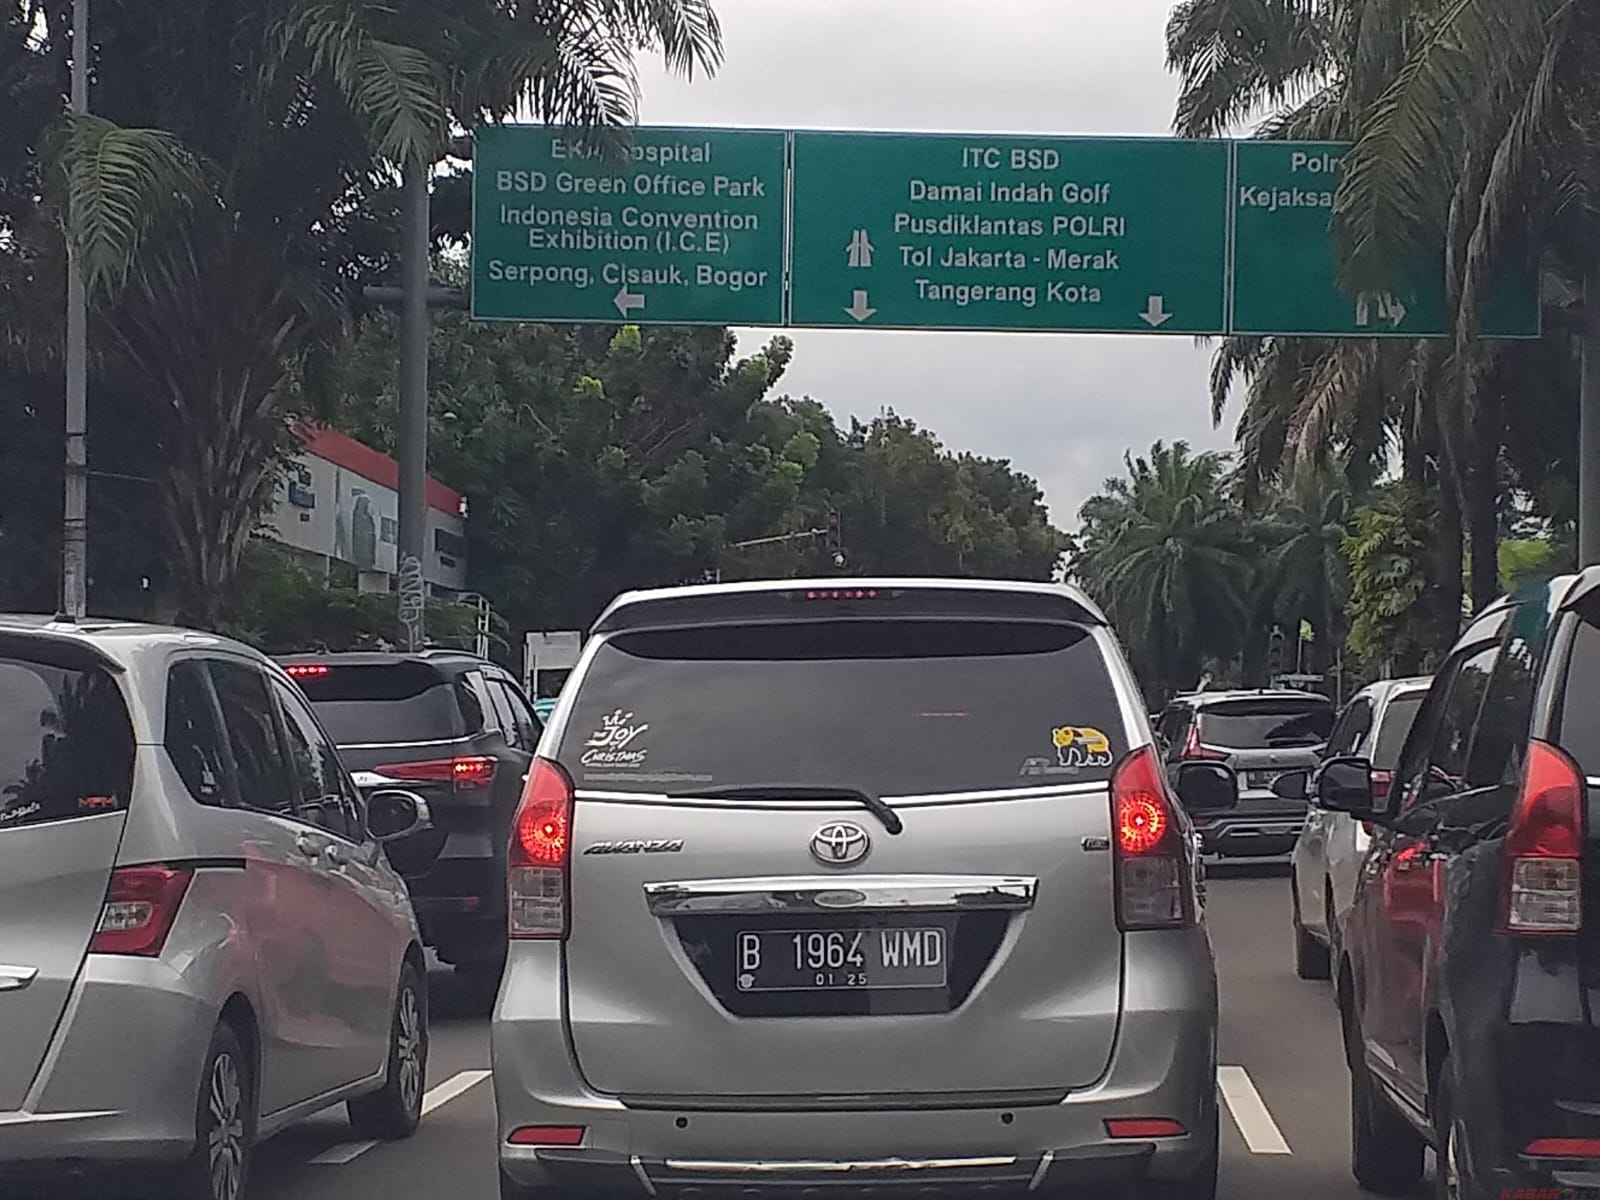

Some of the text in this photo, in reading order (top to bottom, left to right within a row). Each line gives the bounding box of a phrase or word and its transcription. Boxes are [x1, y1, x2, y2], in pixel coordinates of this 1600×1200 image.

[962, 147, 1060, 170] ITC BSD
[1291, 152, 1340, 174] Polr
[496, 171, 766, 198] BSD Green Office Park
[909, 180, 1111, 204] Damai Indah Golf
[1240, 186, 1333, 212] Kejaksa
[500, 204, 759, 230] Indonesia Convention
[893, 213, 1126, 236] Pusdiklantas POLRI
[528, 229, 730, 255] Exhibition (I.C.E)
[899, 246, 932, 267] Tol
[940, 247, 1026, 269] Jakarta
[1048, 250, 1119, 270] Merak
[488, 260, 768, 291] Serpong, Cisauk, Bogor
[915, 279, 1101, 308] Tangerang Kota
[743, 931, 942, 970] B 1964 WMD
[815, 972, 868, 986] 01 25
